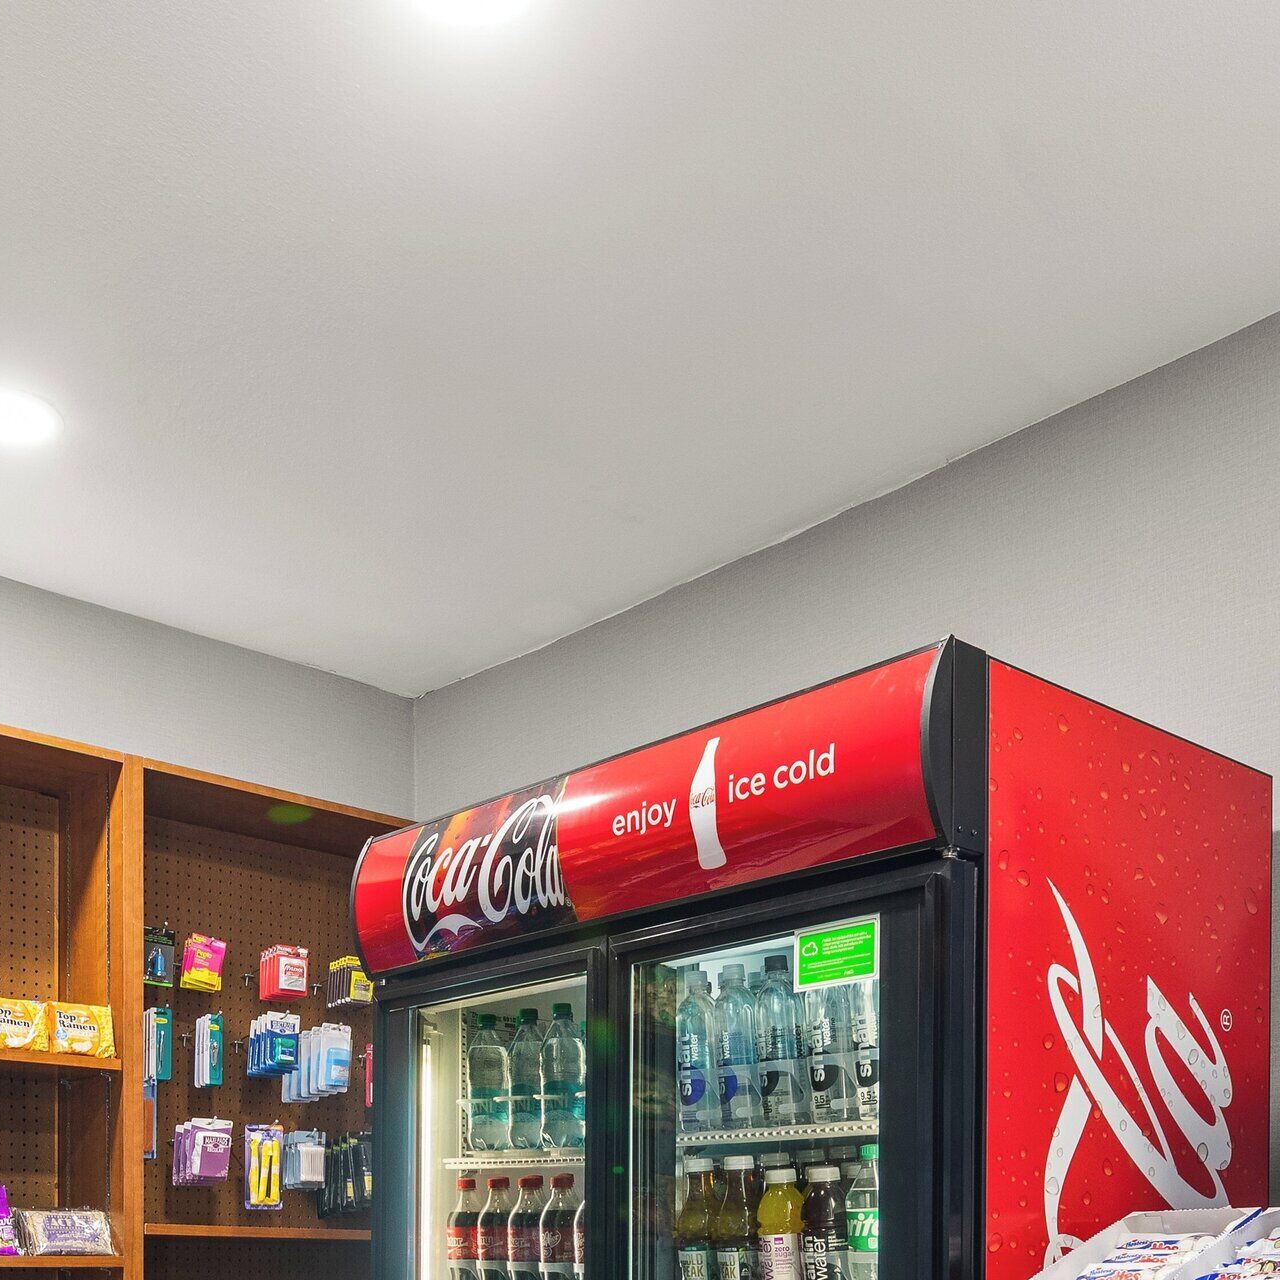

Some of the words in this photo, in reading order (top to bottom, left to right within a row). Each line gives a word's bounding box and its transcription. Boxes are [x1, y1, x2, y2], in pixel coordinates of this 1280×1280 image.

[727, 773, 766, 803] ice
[772, 743, 836, 791] cold
[611, 798, 677, 838] enjoy
[56, 1010, 77, 1022] Top
[59, 1020, 96, 1032] Ramen
